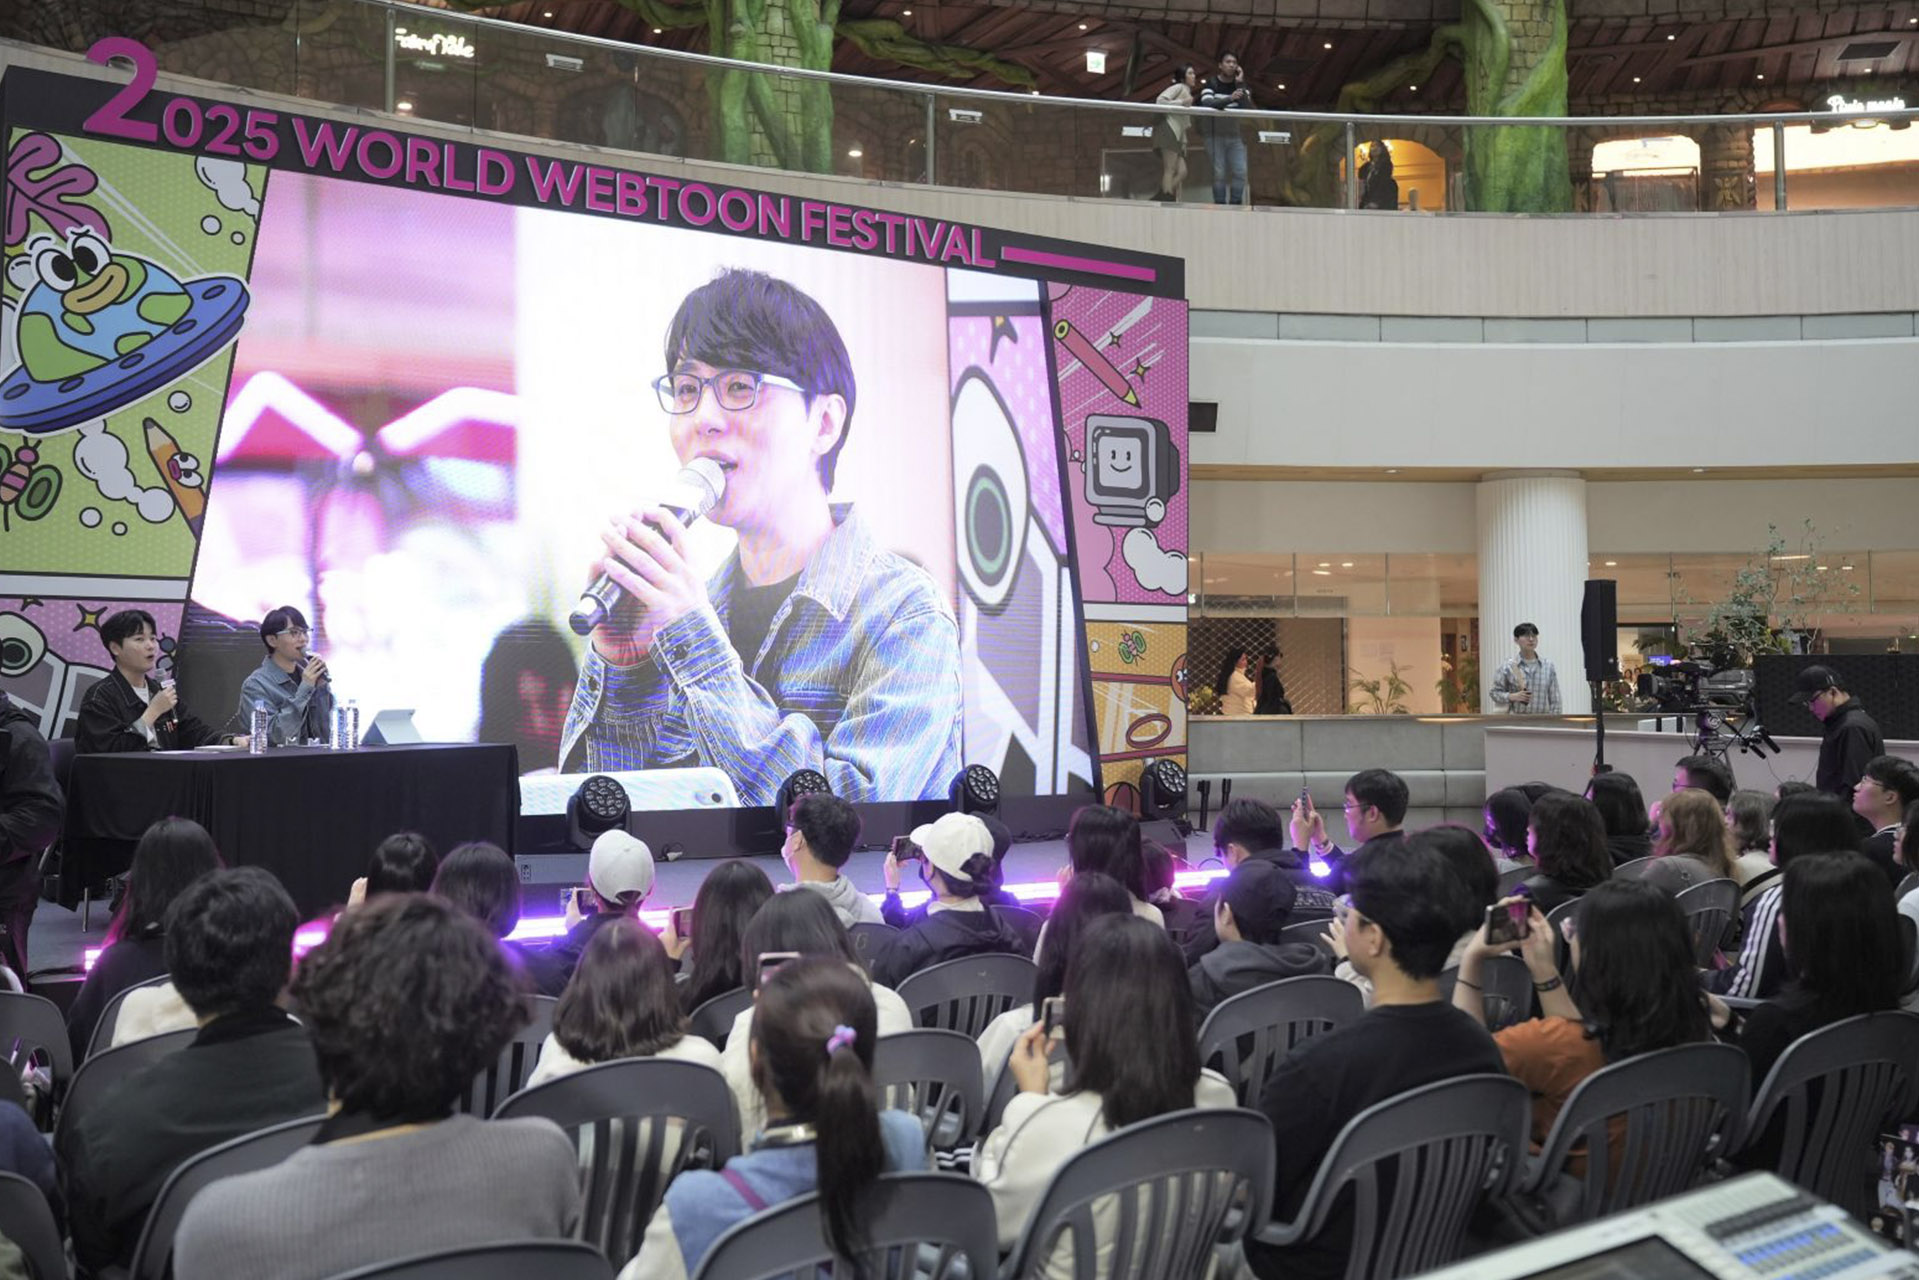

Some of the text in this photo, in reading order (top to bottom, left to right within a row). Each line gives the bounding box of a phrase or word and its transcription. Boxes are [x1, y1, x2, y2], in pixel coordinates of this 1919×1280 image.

[83, 36, 997, 268] 2025 WORLD WEBTOON FESTIVAL
